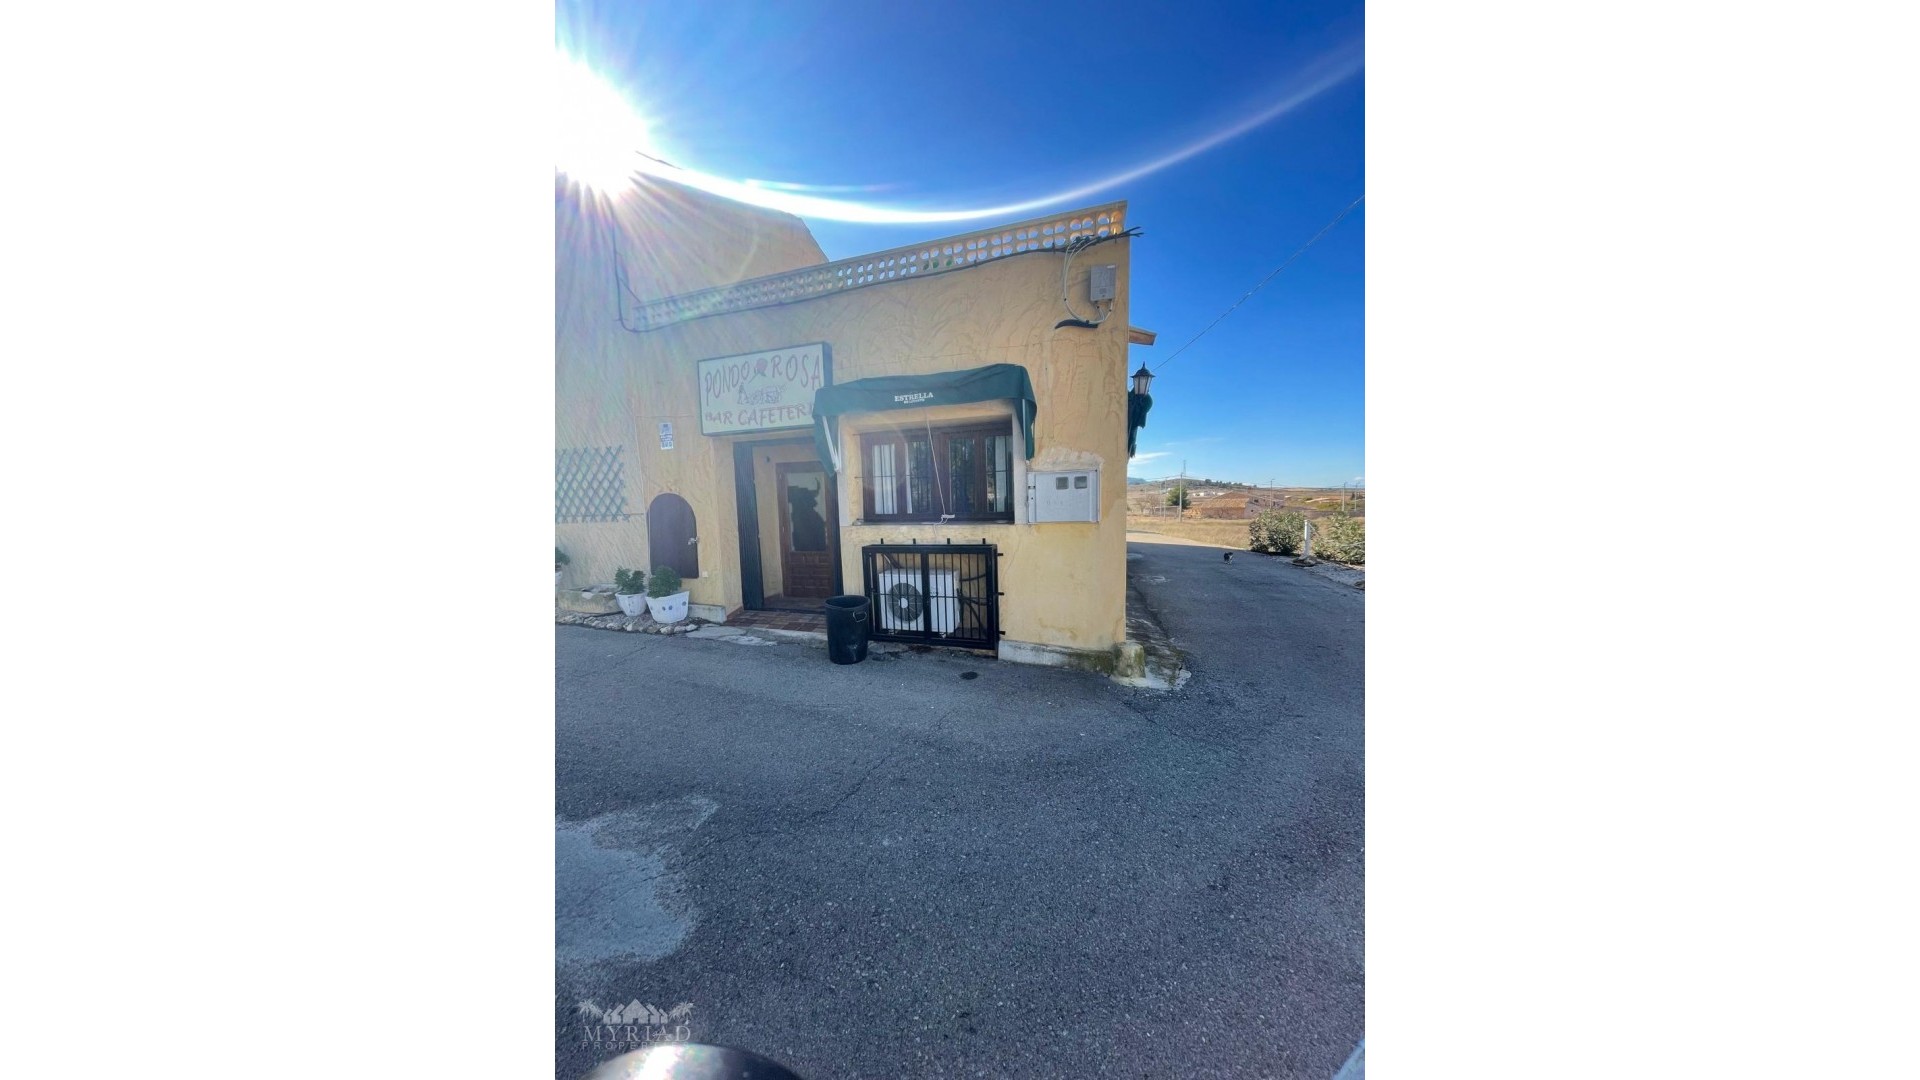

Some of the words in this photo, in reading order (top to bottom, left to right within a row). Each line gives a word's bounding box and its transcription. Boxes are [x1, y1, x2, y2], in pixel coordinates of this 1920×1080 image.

[705, 360, 750, 406] PONDO
[770, 354, 821, 391] ROSA
[894, 391, 934, 402] ESTRELLA
[705, 410, 733, 425] BAR
